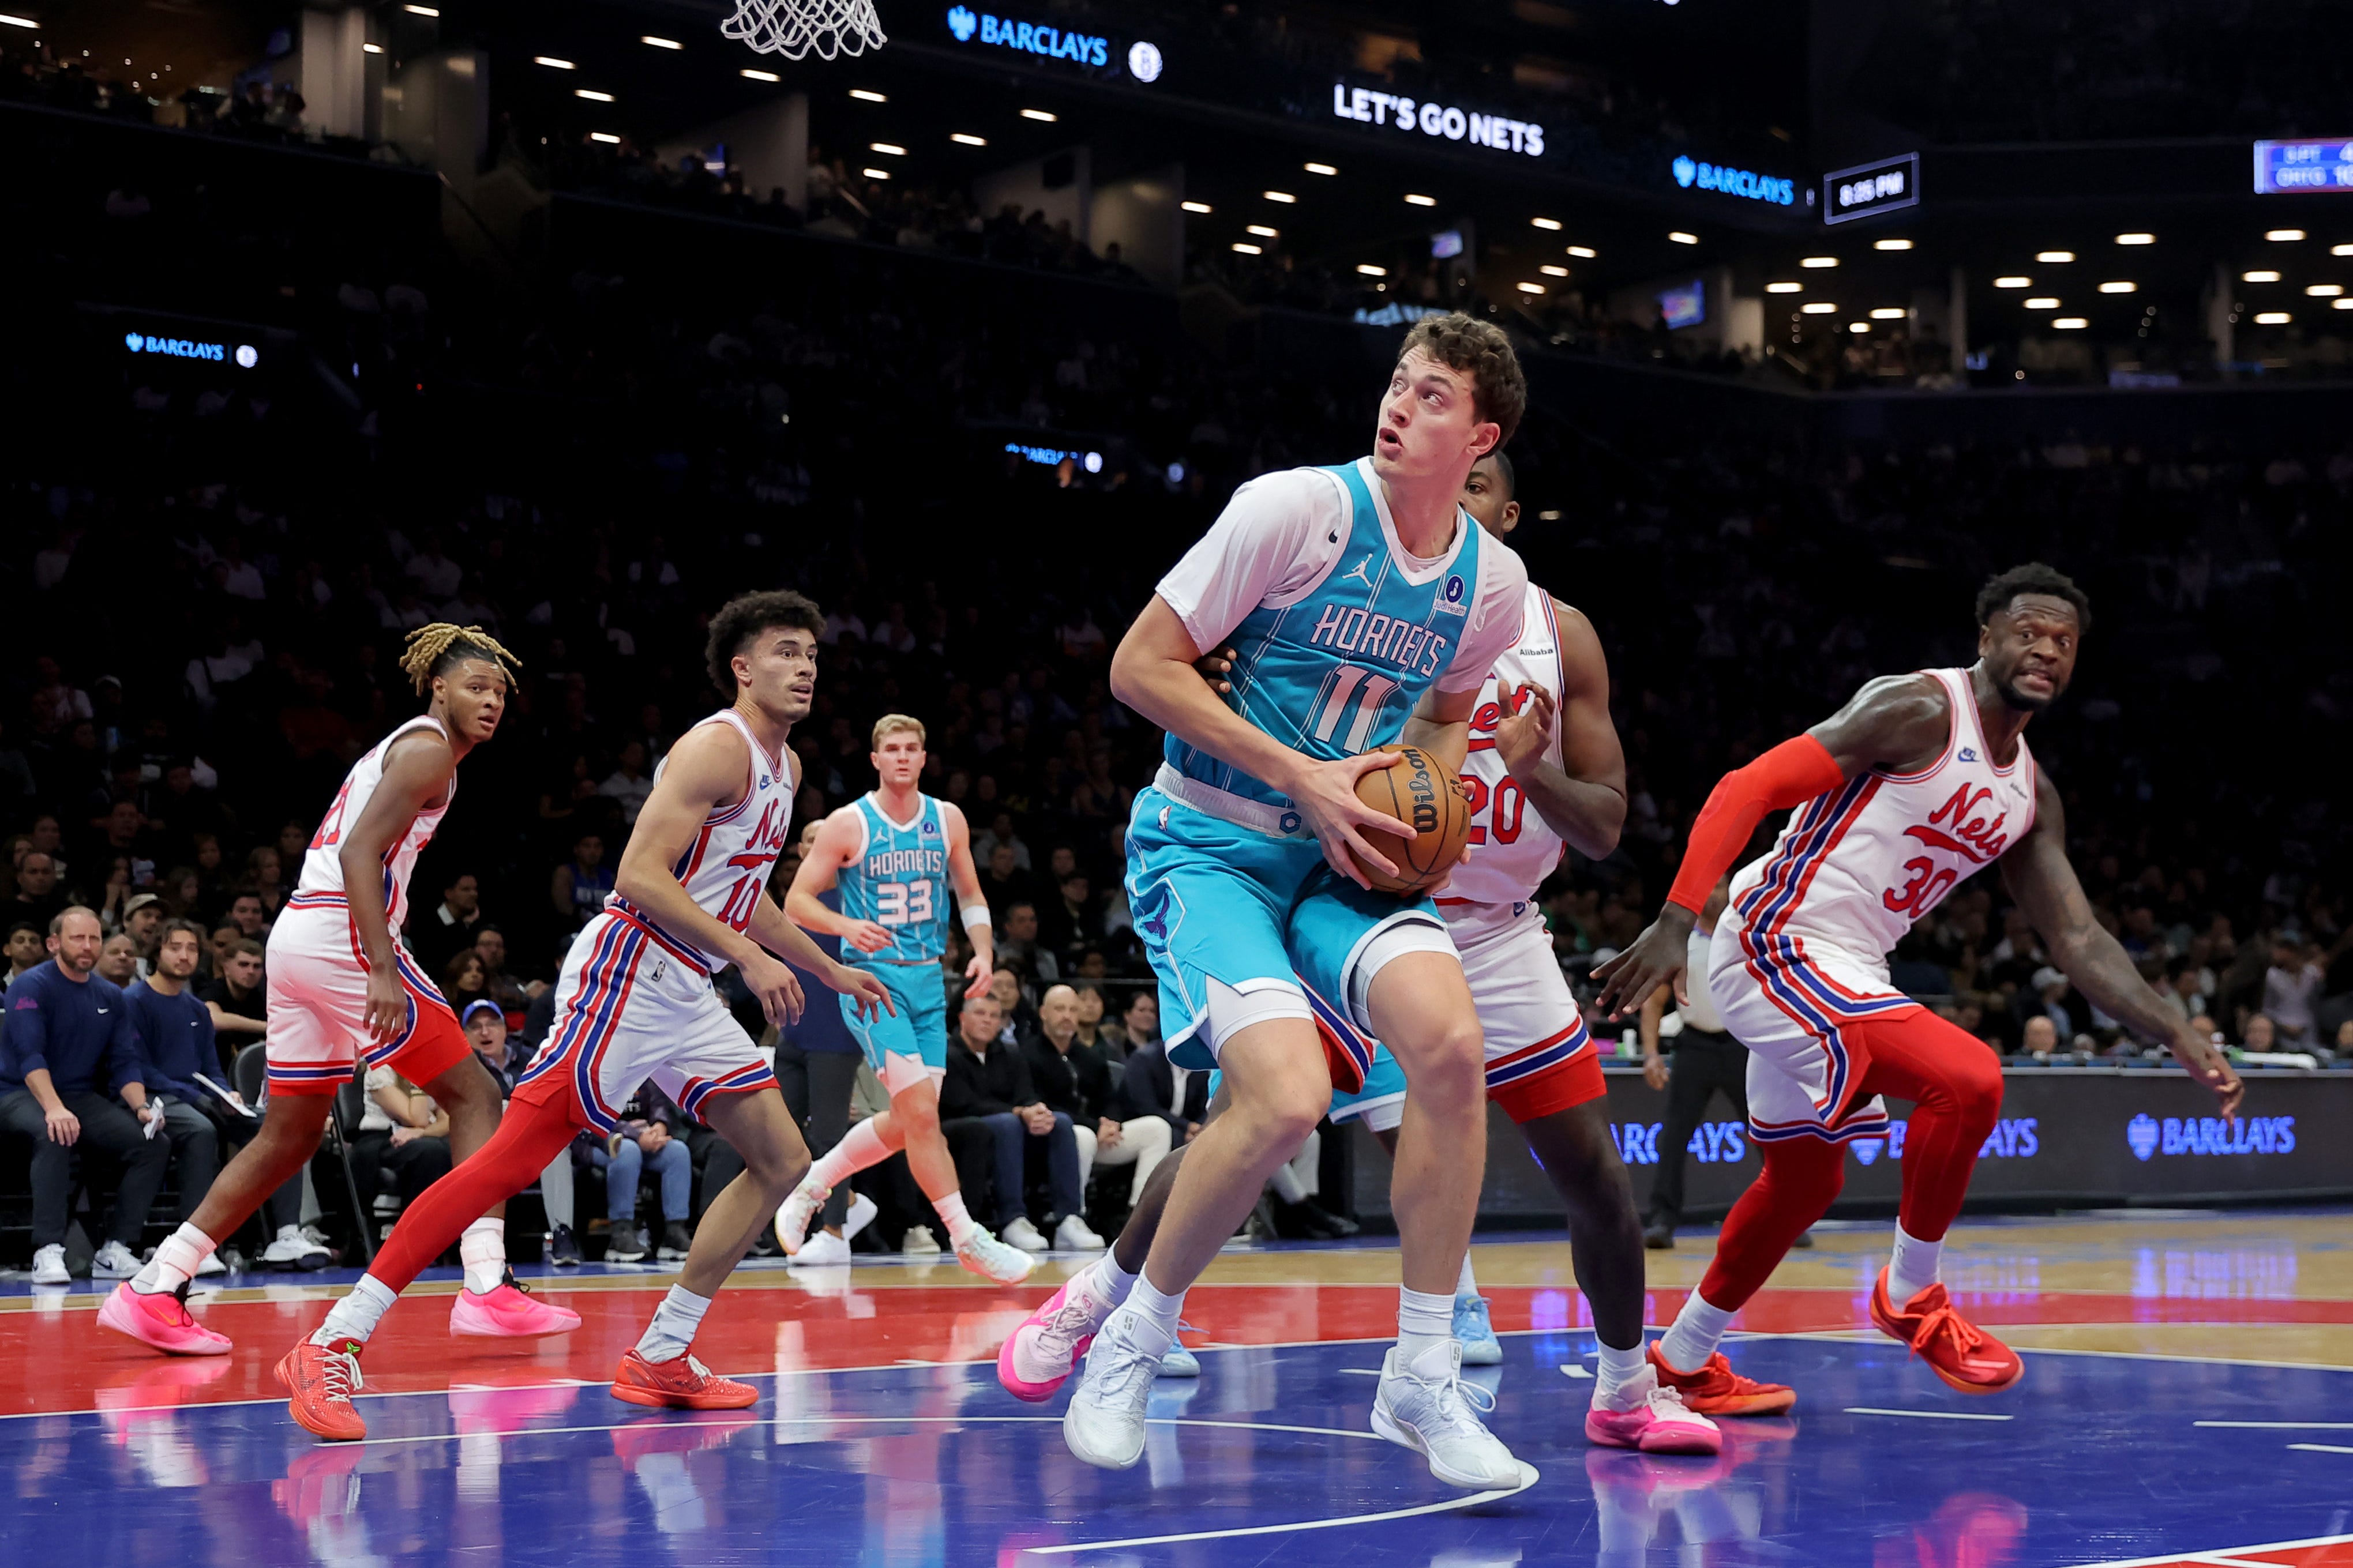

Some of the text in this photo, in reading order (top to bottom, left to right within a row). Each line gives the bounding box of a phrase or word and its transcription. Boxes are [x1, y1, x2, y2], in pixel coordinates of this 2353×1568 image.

[981, 14, 1108, 66] BARCLAYS
[1334, 83, 1545, 156] LET'S GO NETS
[1697, 162, 1794, 206] BARCLAYS
[146, 336, 224, 360] BARCLAYS
[1433, 600, 1466, 615] Judi Health
[1310, 604, 1447, 678] HORNETS
[1519, 648, 1554, 656] Alibaba
[1314, 664, 1398, 755] 11
[1402, 749, 1438, 833] Wilson
[1458, 774, 1526, 845] 20
[1928, 782, 2007, 856] Nets
[869, 849, 942, 877] HORNETS
[1883, 856, 1958, 918] 30
[716, 873, 761, 933] 10
[877, 879, 932, 924] 33
[2163, 1116, 2296, 1156] BARCLAYS
